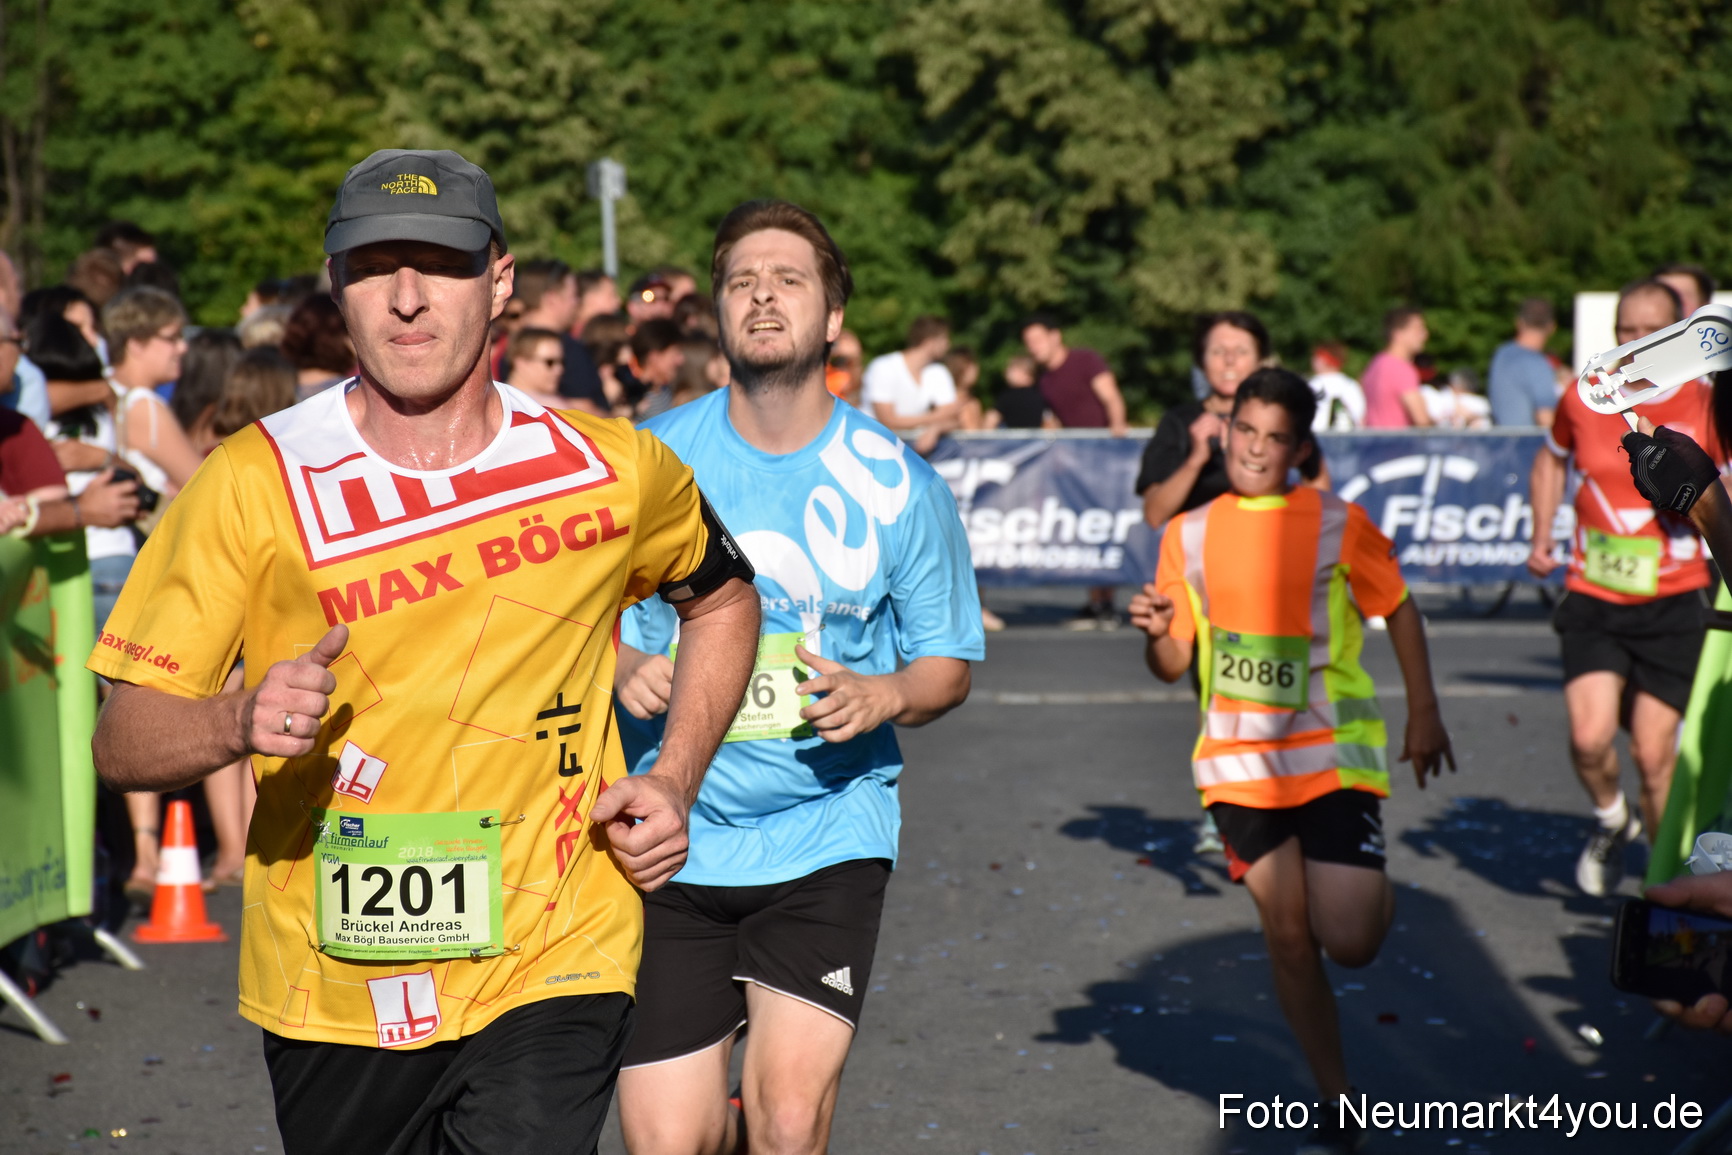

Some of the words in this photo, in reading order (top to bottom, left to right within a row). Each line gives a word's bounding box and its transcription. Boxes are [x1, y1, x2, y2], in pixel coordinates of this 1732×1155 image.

[397, 173, 418, 181] THE
[381, 180, 418, 190] NORTH
[390, 187, 418, 195] FACE
[316, 552, 465, 628] MAX
[476, 506, 630, 579] BÖGL
[1221, 653, 1295, 689] 2086
[740, 711, 774, 722] Stefan
[331, 832, 390, 849] firmenlauf
[398, 846, 434, 860] 2018
[331, 863, 466, 917] 1201
[341, 918, 394, 933] Brückel
[399, 919, 463, 932] Andreas
[335, 933, 351, 943] Max
[353, 935, 376, 946] Bögl
[378, 936, 435, 945] Bauservice
[438, 933, 470, 943] GmbH
